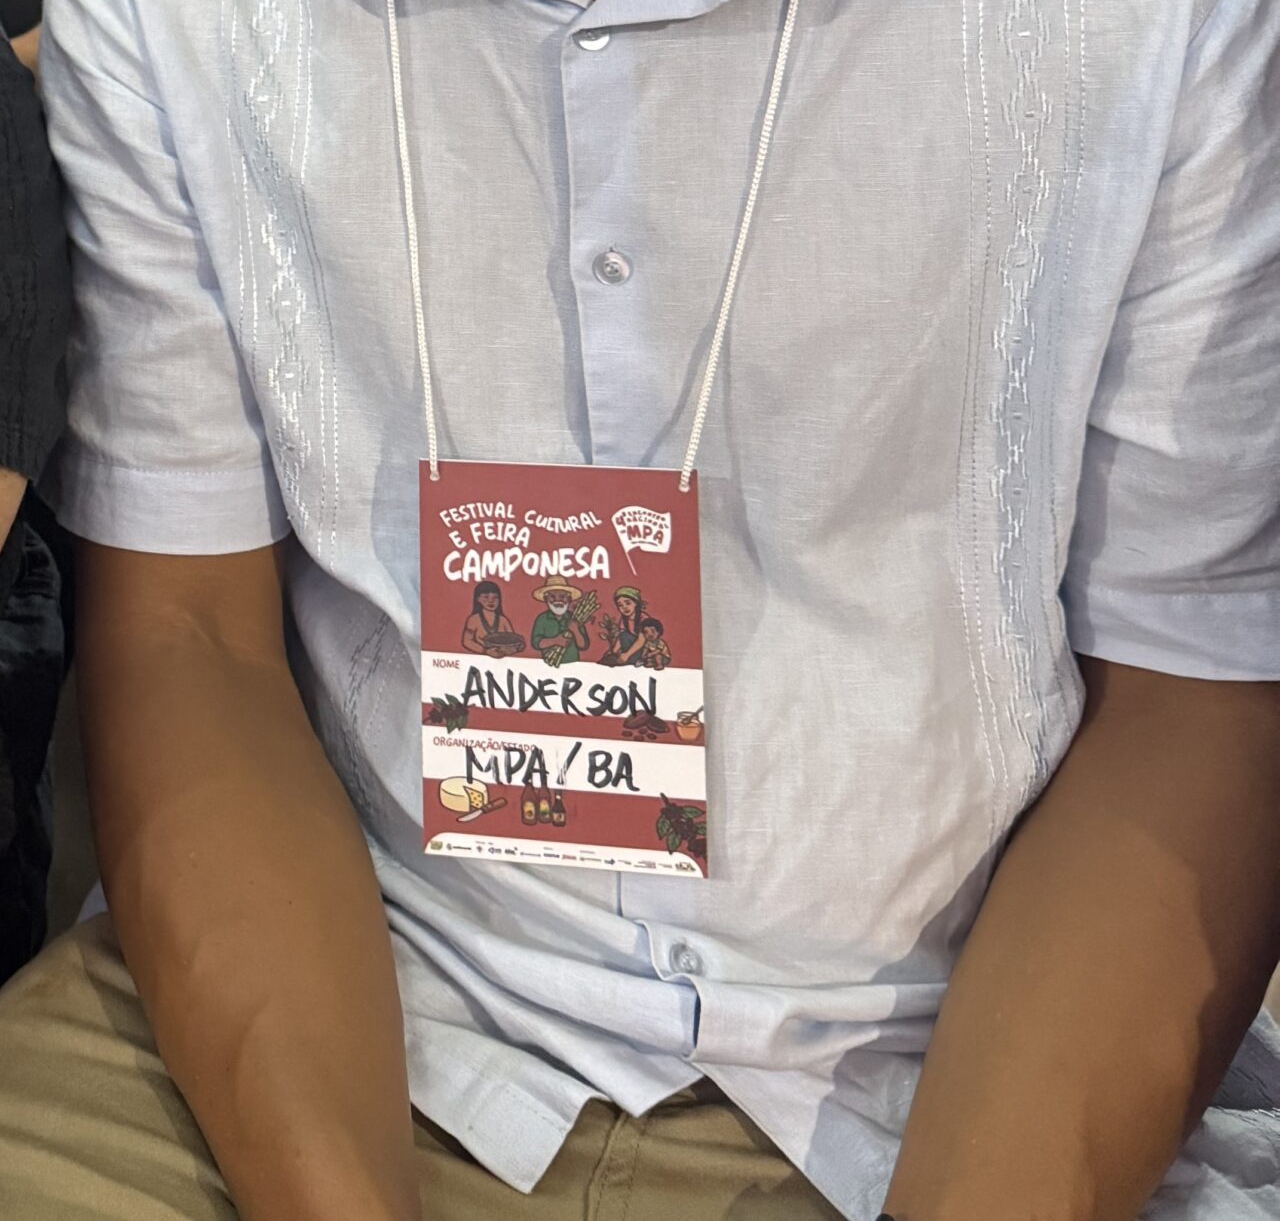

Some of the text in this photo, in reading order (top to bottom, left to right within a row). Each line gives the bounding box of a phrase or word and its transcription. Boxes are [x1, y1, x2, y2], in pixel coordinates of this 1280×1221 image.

[439, 502, 602, 534] FESTIVAL CULTURAL
[449, 522, 531, 549] E FEIRA
[627, 524, 664, 545] MPA
[443, 545, 611, 582] CAMPONESA
[432, 658, 460, 669] NOME
[461, 665, 657, 717] ANDERSON
